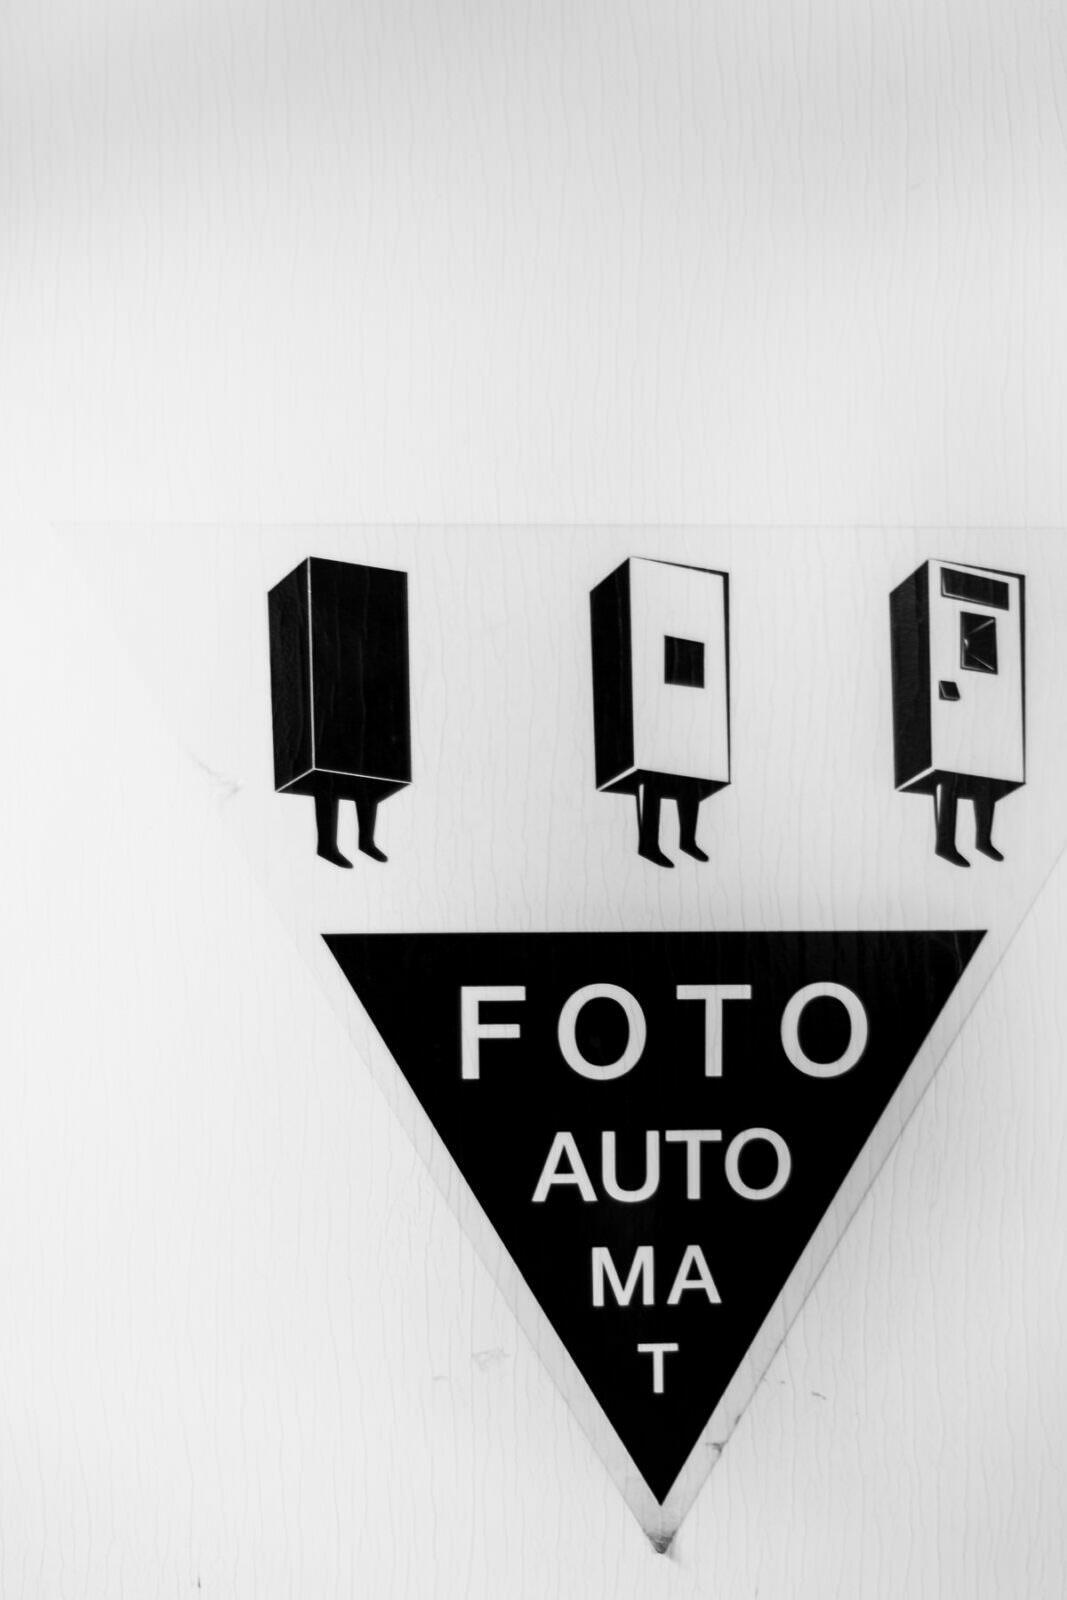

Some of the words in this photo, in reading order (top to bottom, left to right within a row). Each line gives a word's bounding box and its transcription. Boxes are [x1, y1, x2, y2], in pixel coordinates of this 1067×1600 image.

[460, 982, 868, 1081] FOTO
[531, 1127, 792, 1203] AUTO
[591, 1244, 722, 1307] MA
[637, 1342, 679, 1394] T
